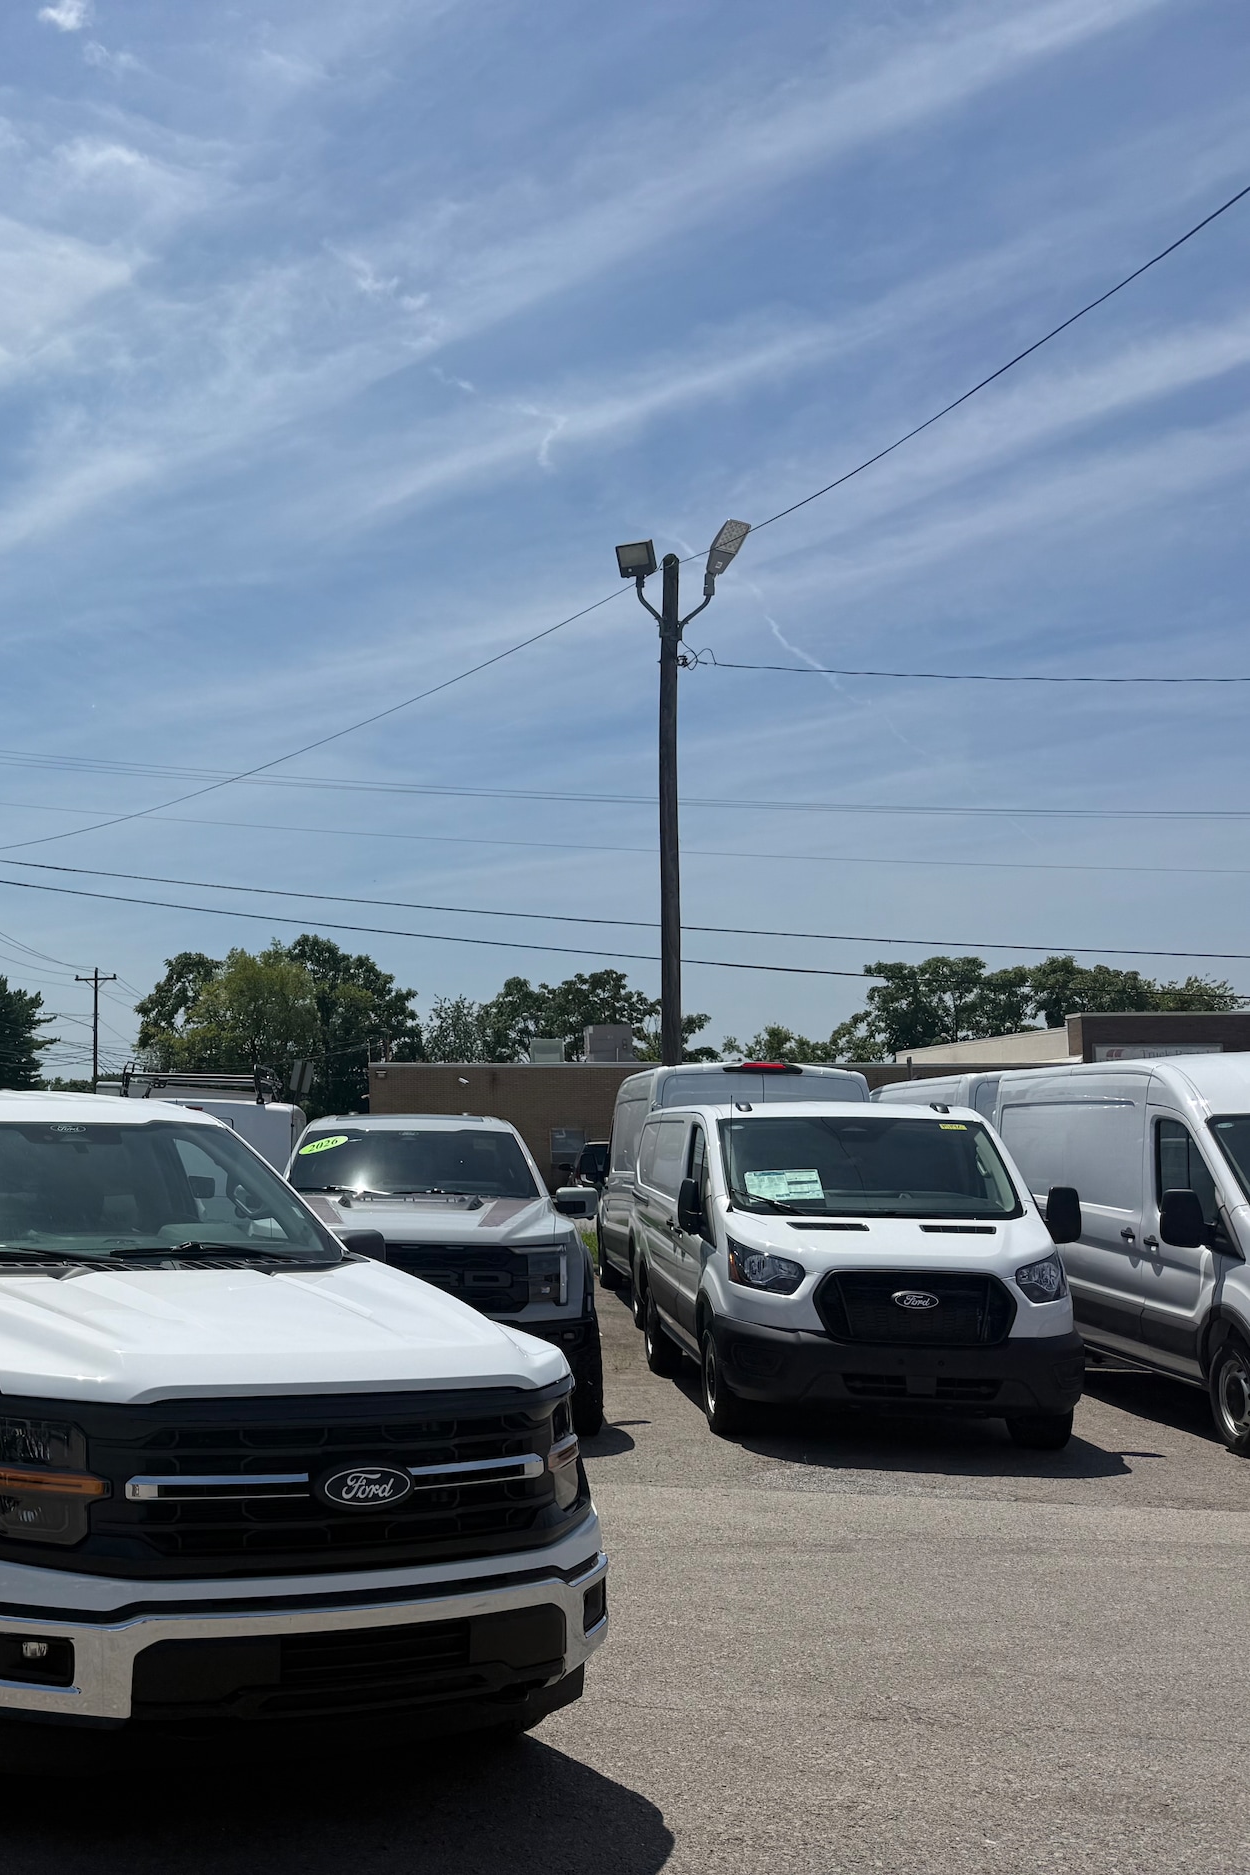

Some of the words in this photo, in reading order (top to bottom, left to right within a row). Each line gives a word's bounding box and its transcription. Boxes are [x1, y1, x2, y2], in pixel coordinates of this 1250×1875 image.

[307, 1137, 339, 1153] 2026
[903, 1294, 931, 1307] Ford
[341, 1472, 395, 1500] Ford
